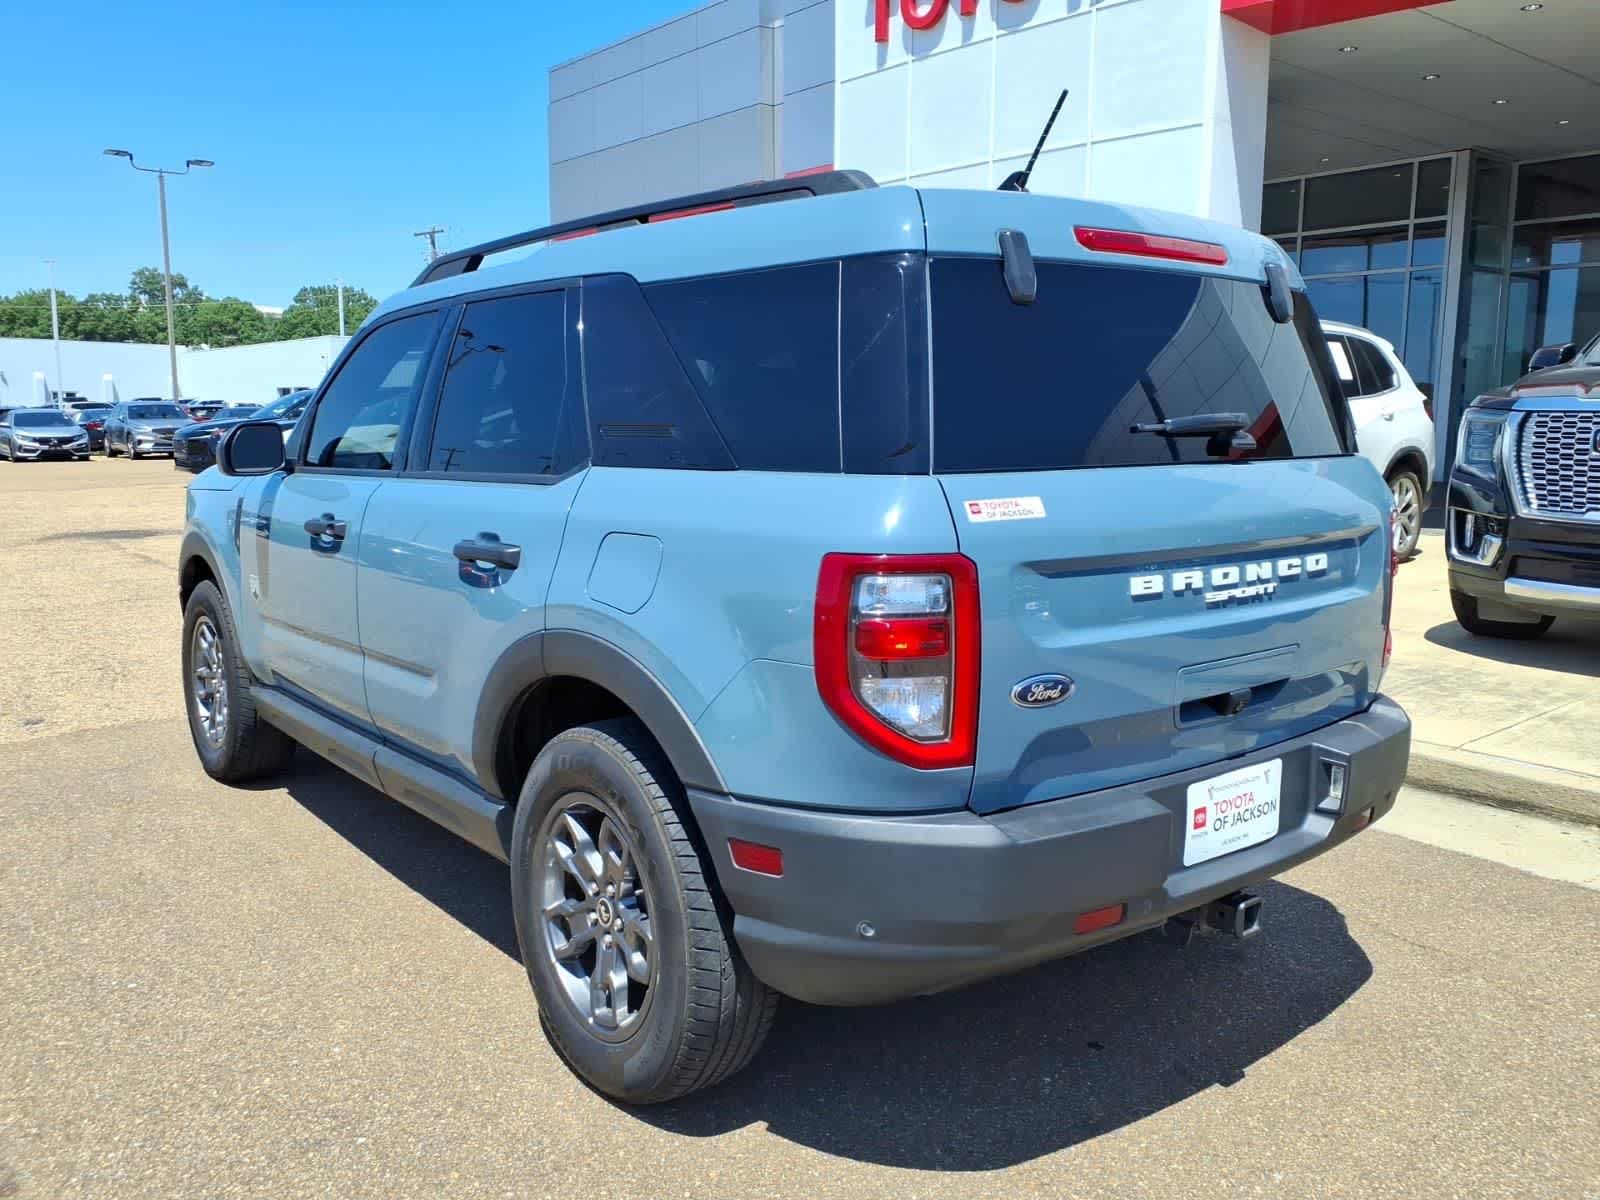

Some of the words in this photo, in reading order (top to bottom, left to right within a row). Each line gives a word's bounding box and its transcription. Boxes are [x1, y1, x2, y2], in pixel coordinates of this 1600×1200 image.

[983, 501, 1021, 510] TOYOTA
[1130, 553, 1328, 596] BRONCO
[1204, 582, 1279, 603] SPORT
[1027, 682, 1062, 702] Ford
[1213, 815, 1229, 832] OF
[1230, 798, 1277, 828] JACKSON
[1214, 792, 1255, 816] TOYOTA
